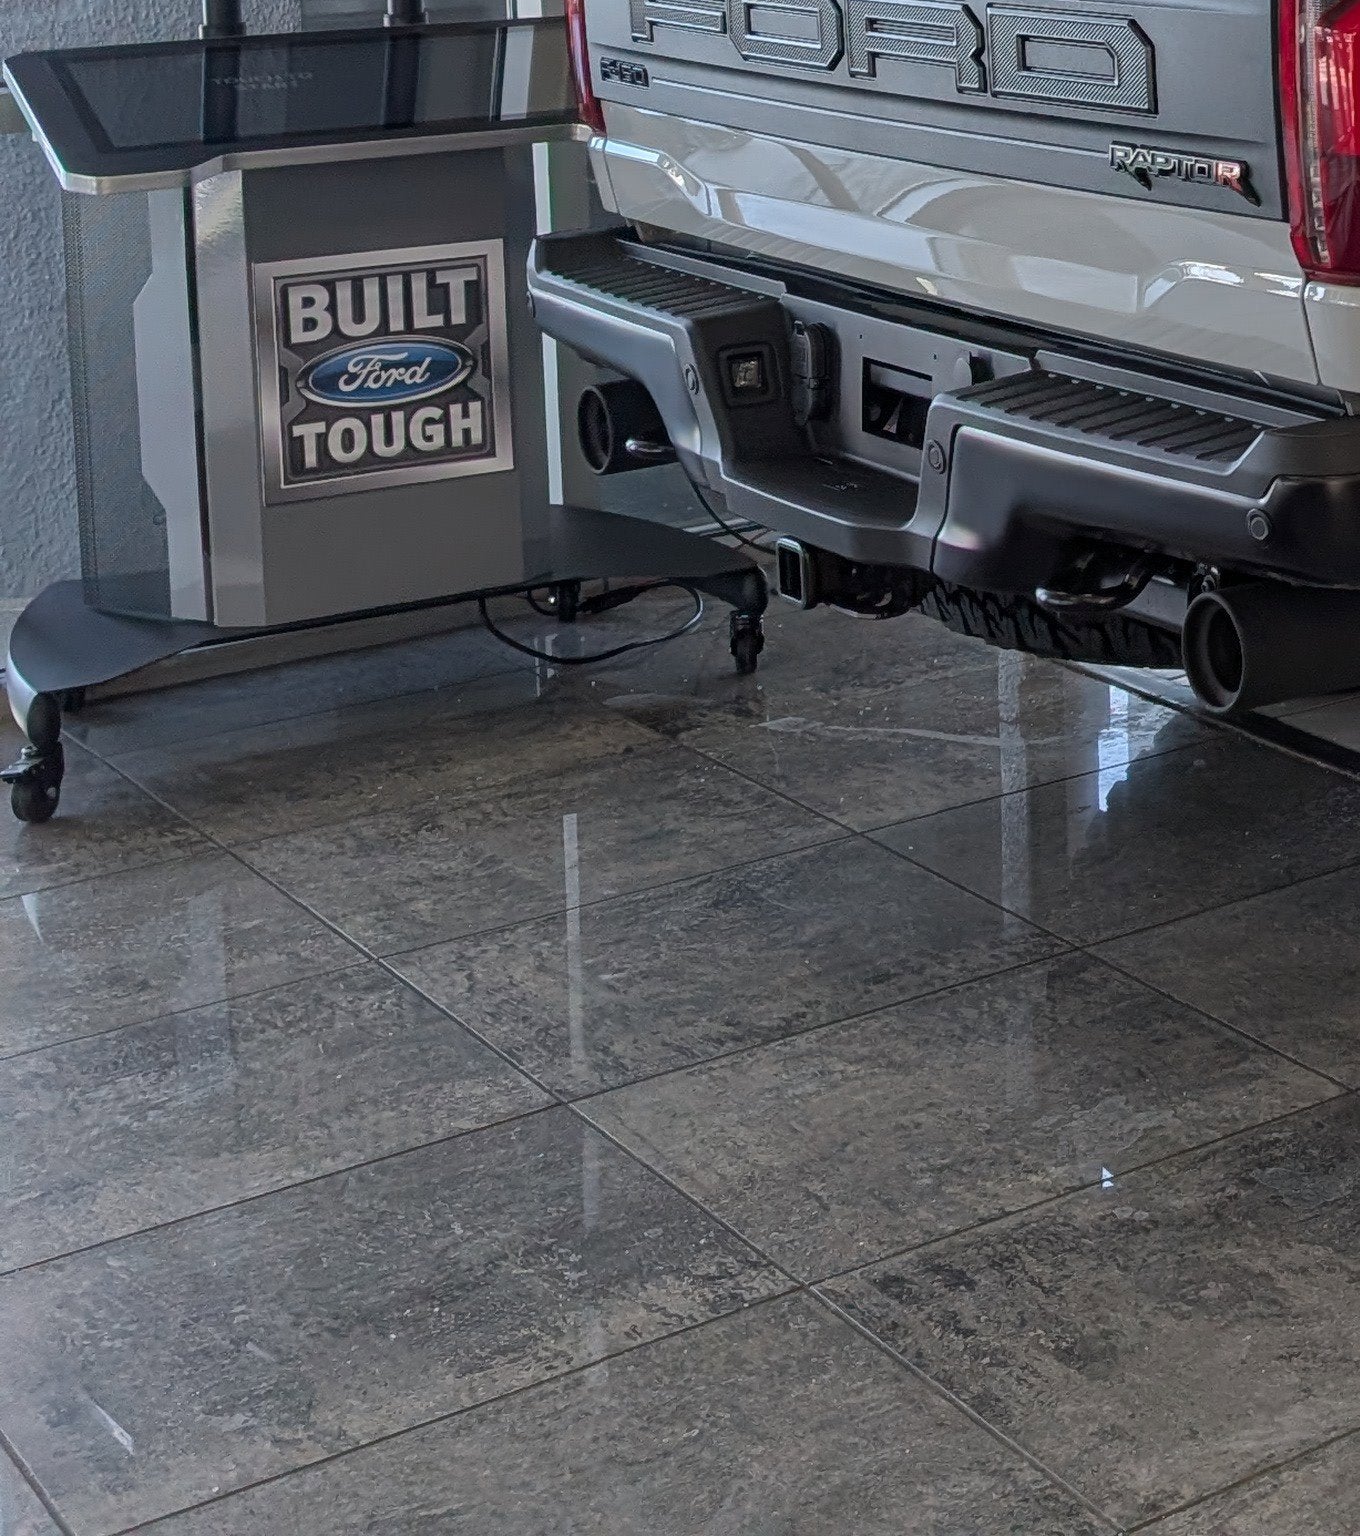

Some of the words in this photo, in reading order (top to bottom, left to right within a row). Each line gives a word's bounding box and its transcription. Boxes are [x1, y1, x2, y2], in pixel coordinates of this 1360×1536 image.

[1109, 140, 1262, 208] RAPTOR
[287, 266, 479, 344] BUILT
[338, 351, 435, 392] Ford
[292, 400, 483, 470] TOUGH
